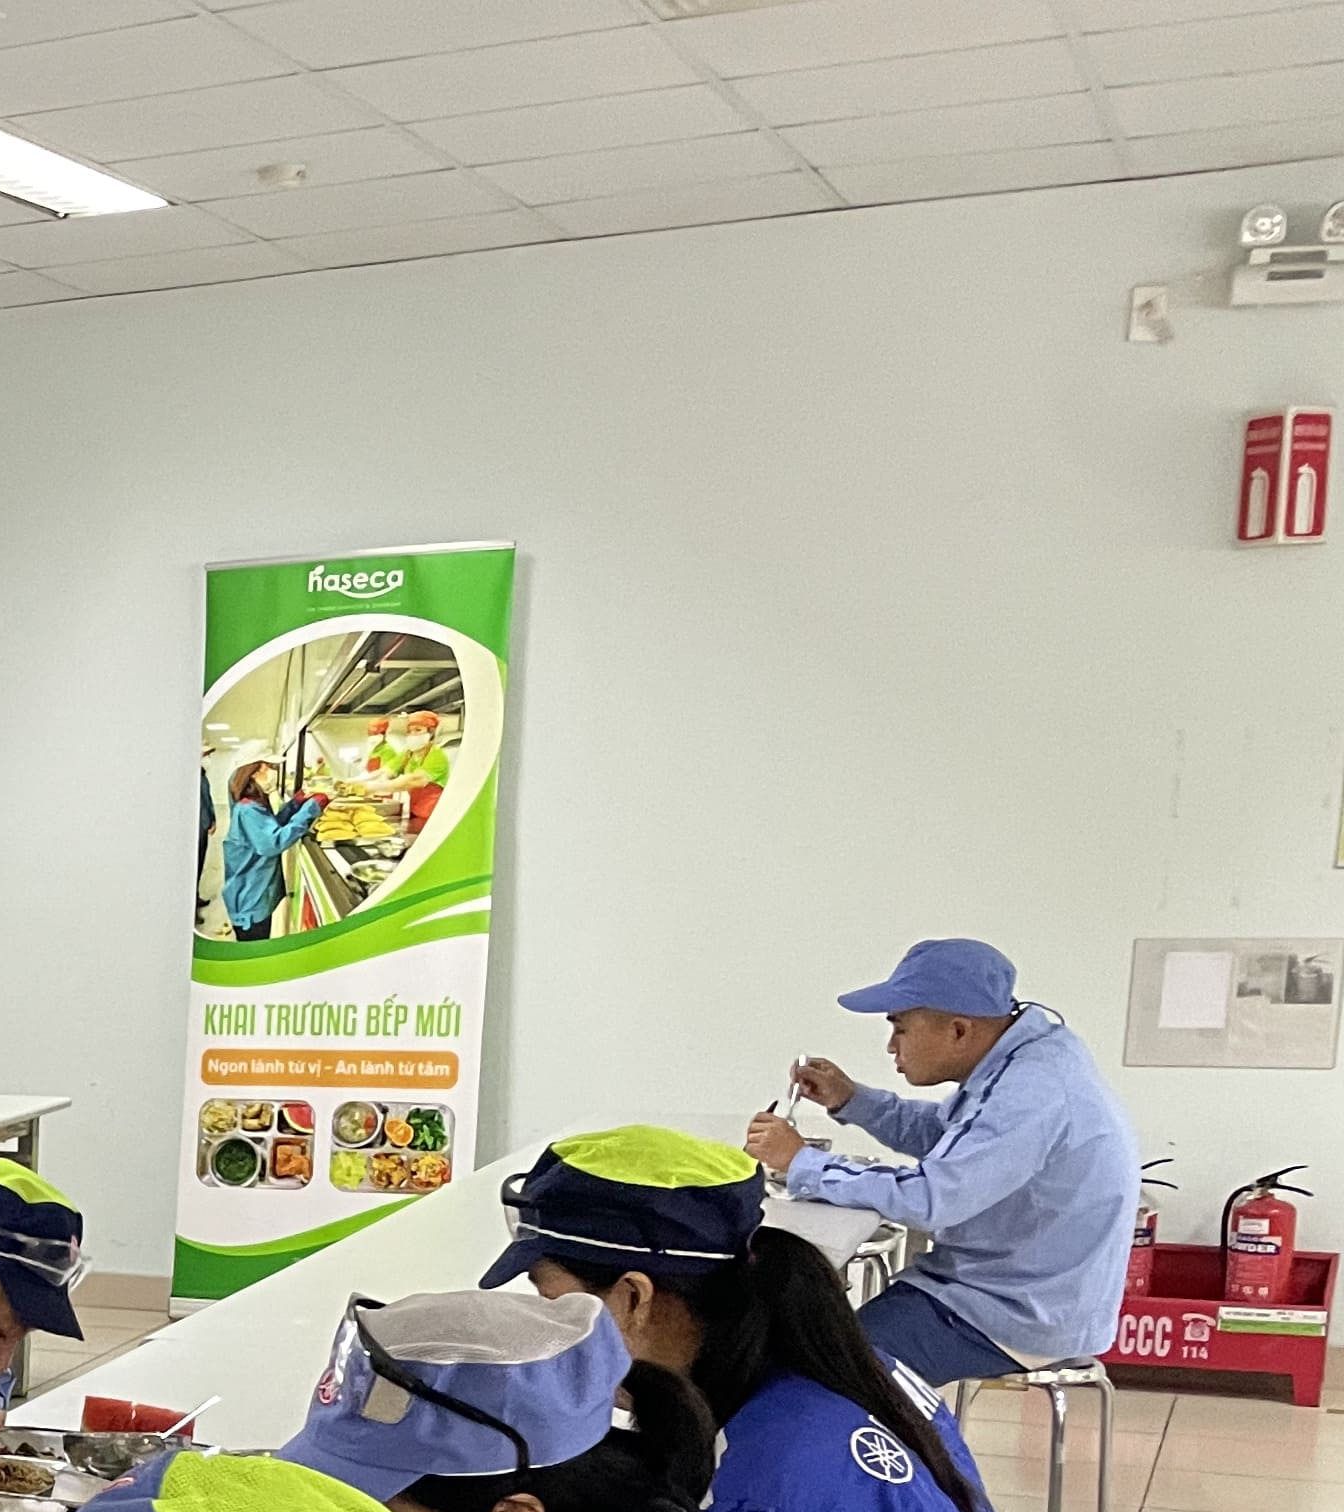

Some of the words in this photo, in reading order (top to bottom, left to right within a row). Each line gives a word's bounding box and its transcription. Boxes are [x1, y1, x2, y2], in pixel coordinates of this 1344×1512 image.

[204, 1004, 256, 1036] KHAI
[265, 1001, 358, 1037] TRƯƠNG
[366, 994, 409, 1037] BẾP
[415, 997, 462, 1038] MỚI
[208, 1059, 248, 1076] Ngon
[335, 1060, 358, 1075] An
[1181, 1346, 1209, 1360] 114
